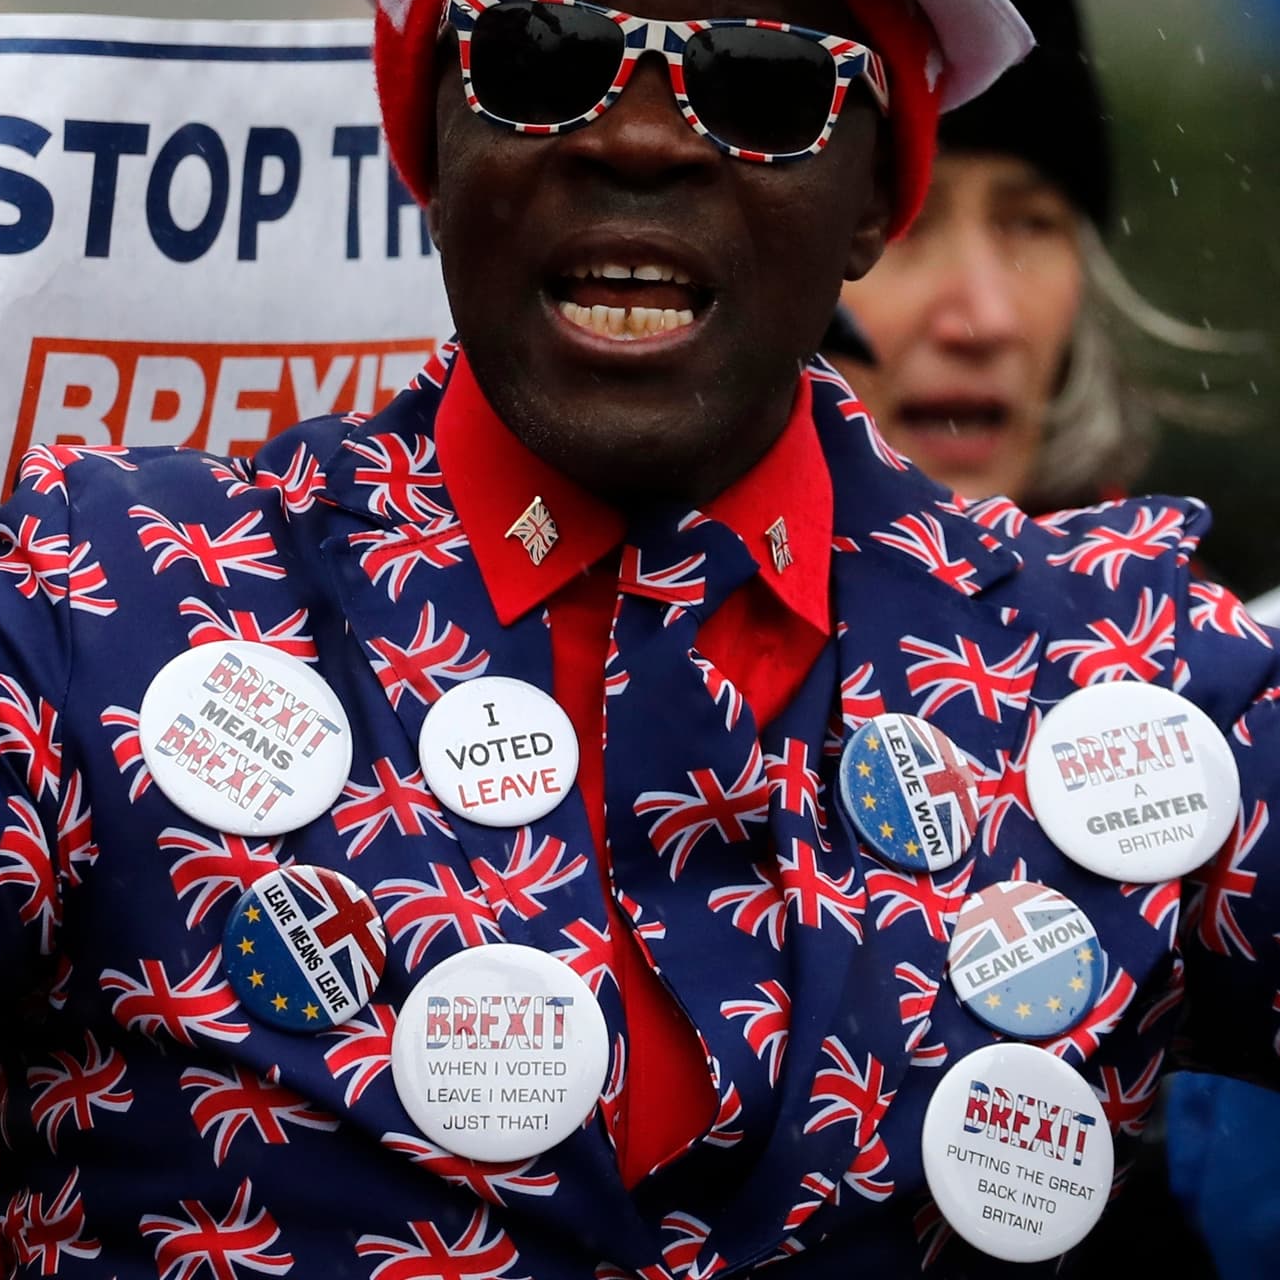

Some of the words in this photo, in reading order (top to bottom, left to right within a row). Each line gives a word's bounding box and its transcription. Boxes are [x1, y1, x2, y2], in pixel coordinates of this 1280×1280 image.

[202, 652, 342, 758] BREXIT
[482, 703, 499, 726] I
[199, 699, 293, 770] MEANS
[446, 732, 554, 770] VOTED
[1052, 715, 1194, 792] BREXIT
[154, 713, 295, 821] BREXIT
[458, 768, 562, 808] LEAVE
[885, 725, 923, 797] LEAVE
[915, 801, 945, 856] WON
[1133, 784, 1148, 798] A
[1086, 792, 1209, 835] GREATER
[1118, 824, 1195, 855] BRITAIN
[263, 884, 297, 926] LEAVE
[288, 925, 324, 971] MEANS
[315, 970, 350, 1014] LEAVE
[965, 947, 1033, 989] LEAVE
[1028, 921, 1087, 954] WON
[426, 996, 574, 1049] BREXIT
[428, 1061, 487, 1076] WHEN
[494, 1061, 499, 1076] I
[505, 1061, 567, 1076] VOTED
[427, 1088, 482, 1103] LEAVE
[488, 1088, 494, 1103] I
[500, 1088, 568, 1103] MEANT
[442, 1114, 490, 1130] JUST
[496, 1113, 549, 1130] THAT!
[963, 1080, 1097, 1166] BREXIT
[946, 1144, 1011, 1175] PUTTING
[1015, 1165, 1045, 1186] THE
[1048, 1176, 1096, 1201] GREAT
[977, 1178, 1018, 1202] BACK
[1021, 1193, 1057, 1214] INTO
[982, 1205, 1044, 1236] BRITAIN!
